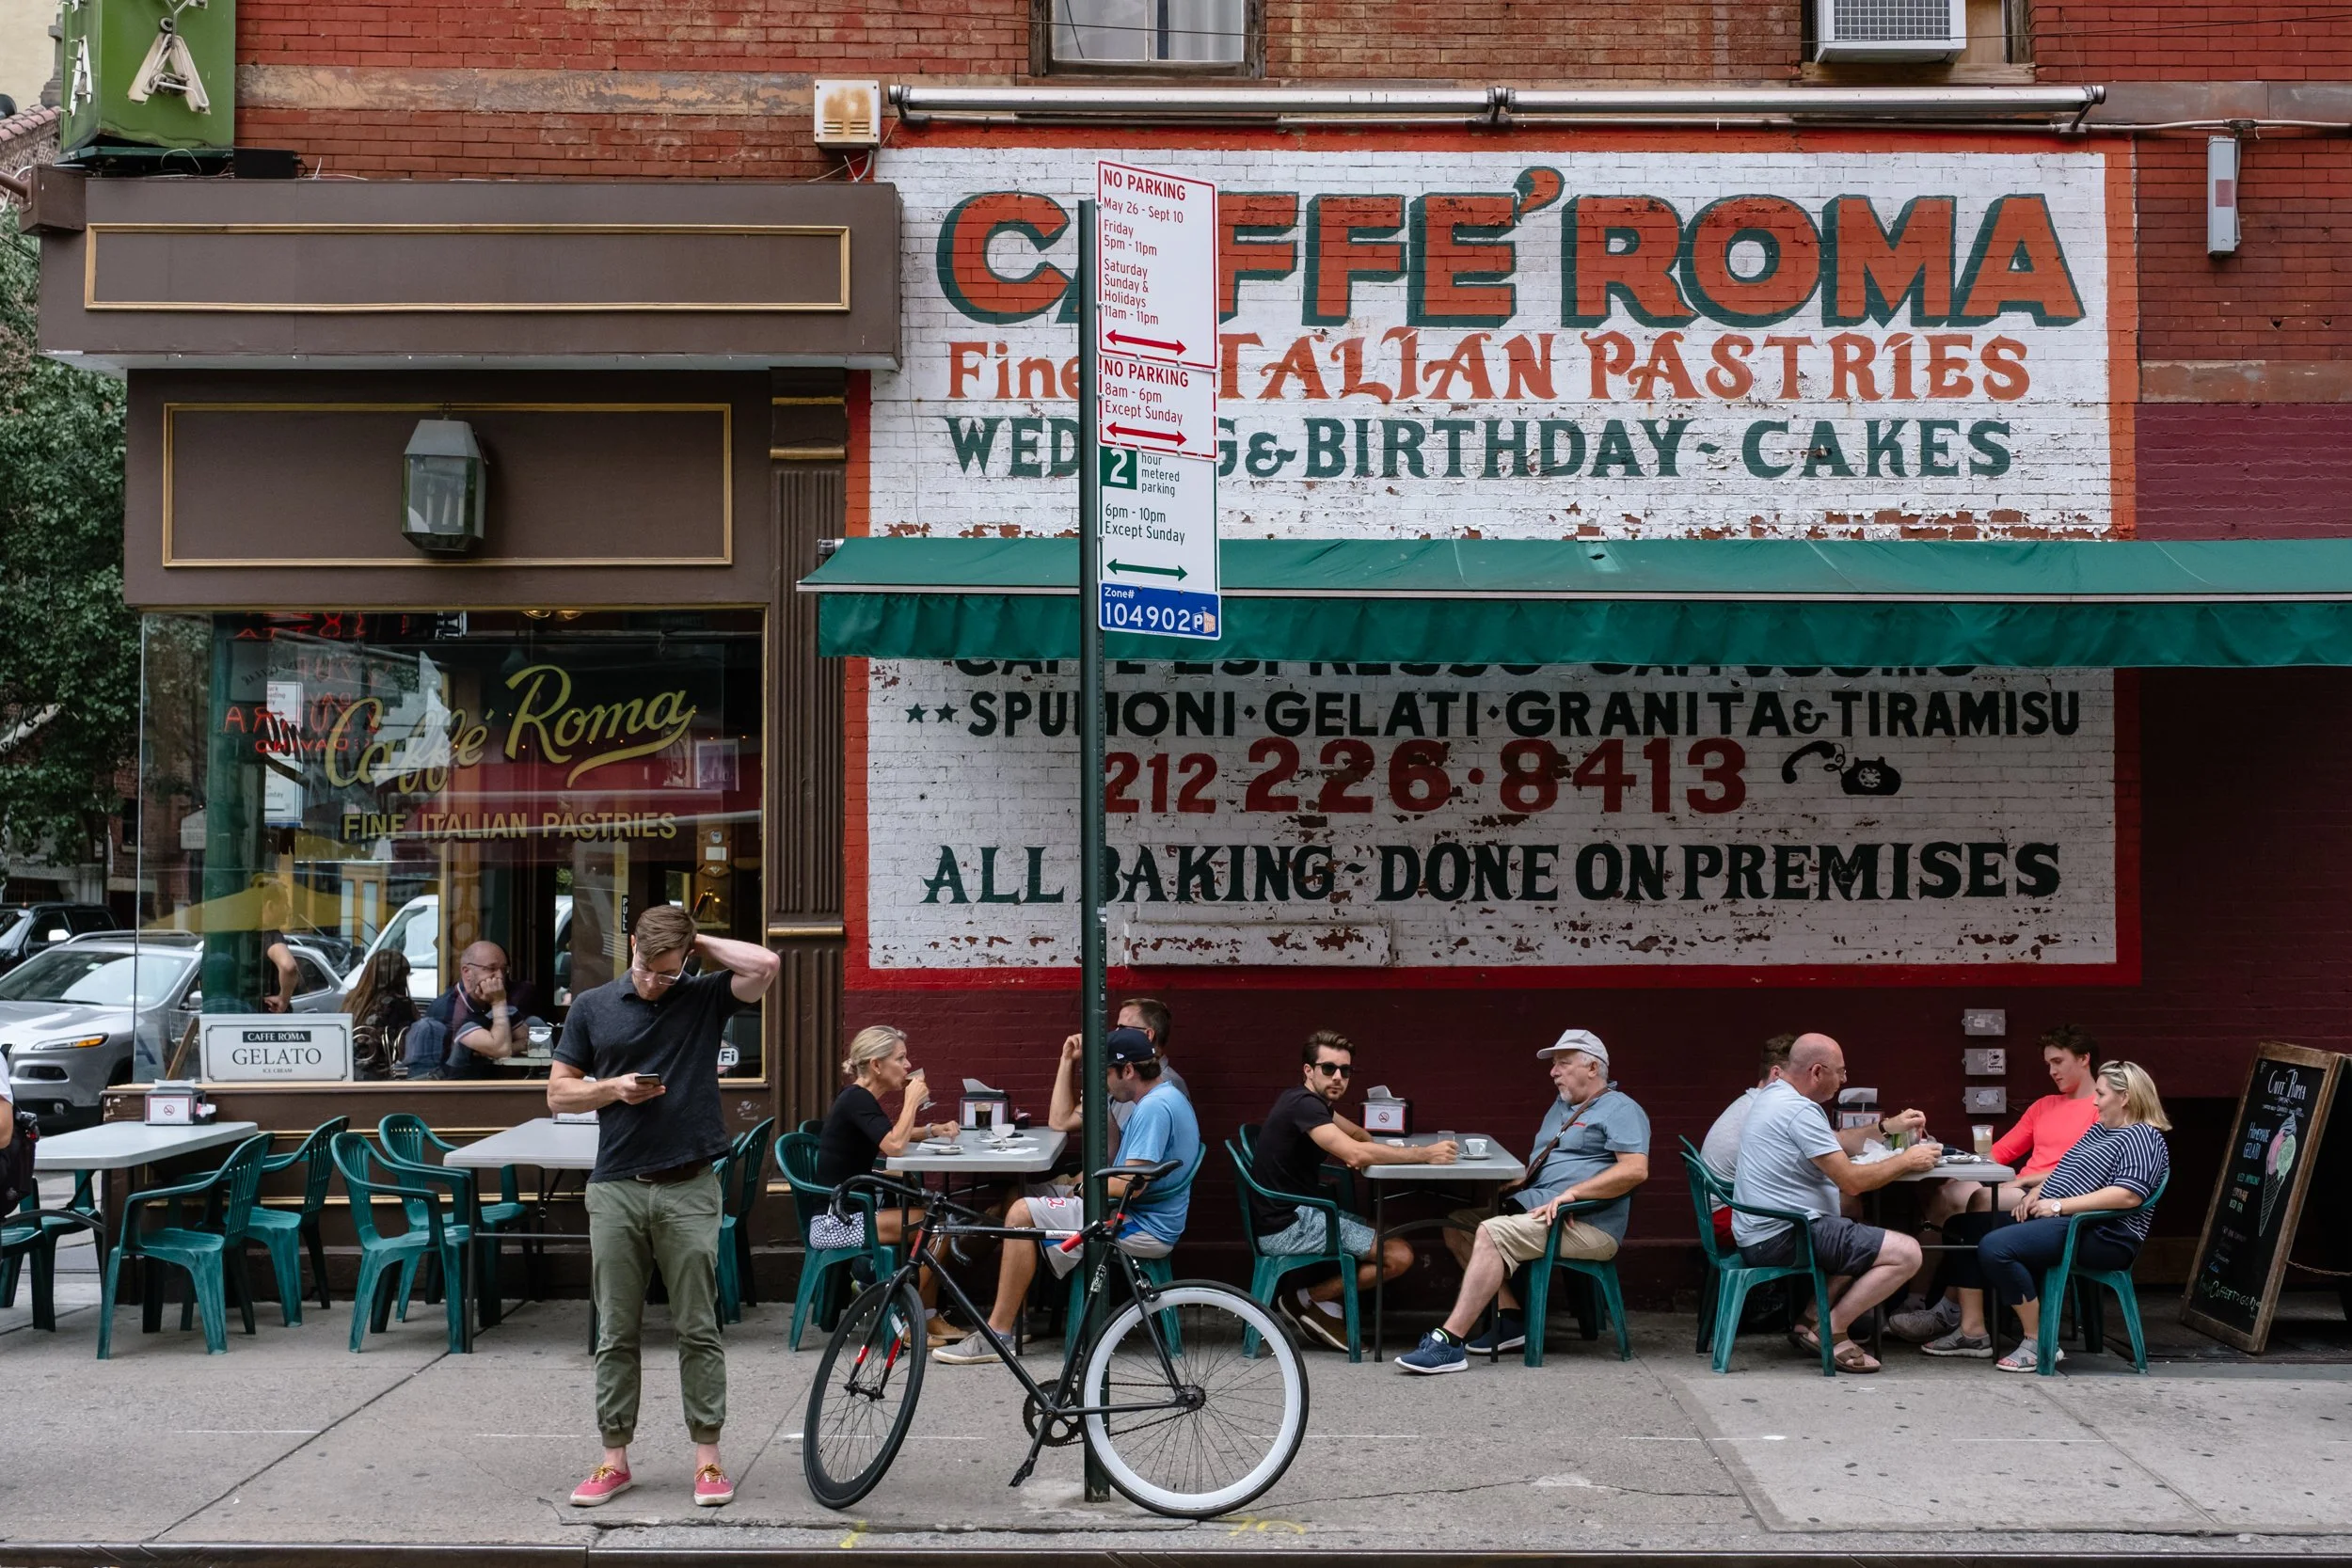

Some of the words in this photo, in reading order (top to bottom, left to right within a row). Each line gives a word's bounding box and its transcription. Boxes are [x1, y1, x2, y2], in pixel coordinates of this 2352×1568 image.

[1104, 168, 1122, 188] NO
[1128, 174, 1186, 201] PARKING
[1104, 197, 1123, 214] May
[1126, 201, 1139, 215] 26
[1148, 205, 1170, 223] Sept
[1173, 210, 1184, 224] 10
[1104, 219, 1135, 239] Friday
[936, 166, 1565, 328] CFFE'
[1561, 193, 2086, 329] ROMA
[1104, 235, 1125, 251] 5pm
[1135, 241, 1157, 257] 11pm
[1104, 259, 1148, 279] Saturday
[1104, 274, 1139, 293] Sunday
[1142, 280, 1149, 293] &
[1104, 290, 1147, 309] Holidays
[1104, 305, 1128, 320] 11am
[1136, 309, 1159, 325] 11pm
[1104, 358, 1123, 378] NO
[1129, 363, 1189, 388] PARKING
[1218, 326, 1559, 404] TALIAN
[1581, 330, 2030, 402] PASTRIES
[1104, 382, 1128, 398] 8am
[1139, 387, 1162, 404] 6pm
[1105, 400, 1141, 419] Except
[1145, 406, 1184, 426] Sunday
[1141, 452, 1162, 467] hour
[1741, 420, 2011, 478] CAKES
[1109, 448, 1128, 484] 2
[1141, 467, 1180, 483] metered
[1141, 482, 1176, 498] parking
[1104, 503, 1128, 520] 6pm
[1139, 507, 1166, 523] 10pm
[1105, 521, 1142, 539] Except
[1146, 524, 1185, 546] Sunday
[1104, 586, 1135, 599] Zone#
[1104, 601, 1191, 632] 104902
[1264, 691, 1478, 736] GELATI
[1831, 691, 2079, 736] TIRAMISU
[504, 664, 697, 788] Roma
[1105, 752, 1217, 814] 212
[342, 814, 407, 839] FINE
[421, 813, 528, 839] ITALIAN
[542, 812, 678, 839] PASTRIES
[919, 845, 1065, 904] ALL
[1374, 842, 1559, 903] DONE
[1575, 842, 1669, 903] ON
[1678, 841, 2062, 901] PREMISES
[247, 1032, 276, 1041] CAFFE
[278, 1032, 306, 1041] ROMA
[231, 1047, 322, 1066] GELATO
[721, 1051, 735, 1062] Fi
